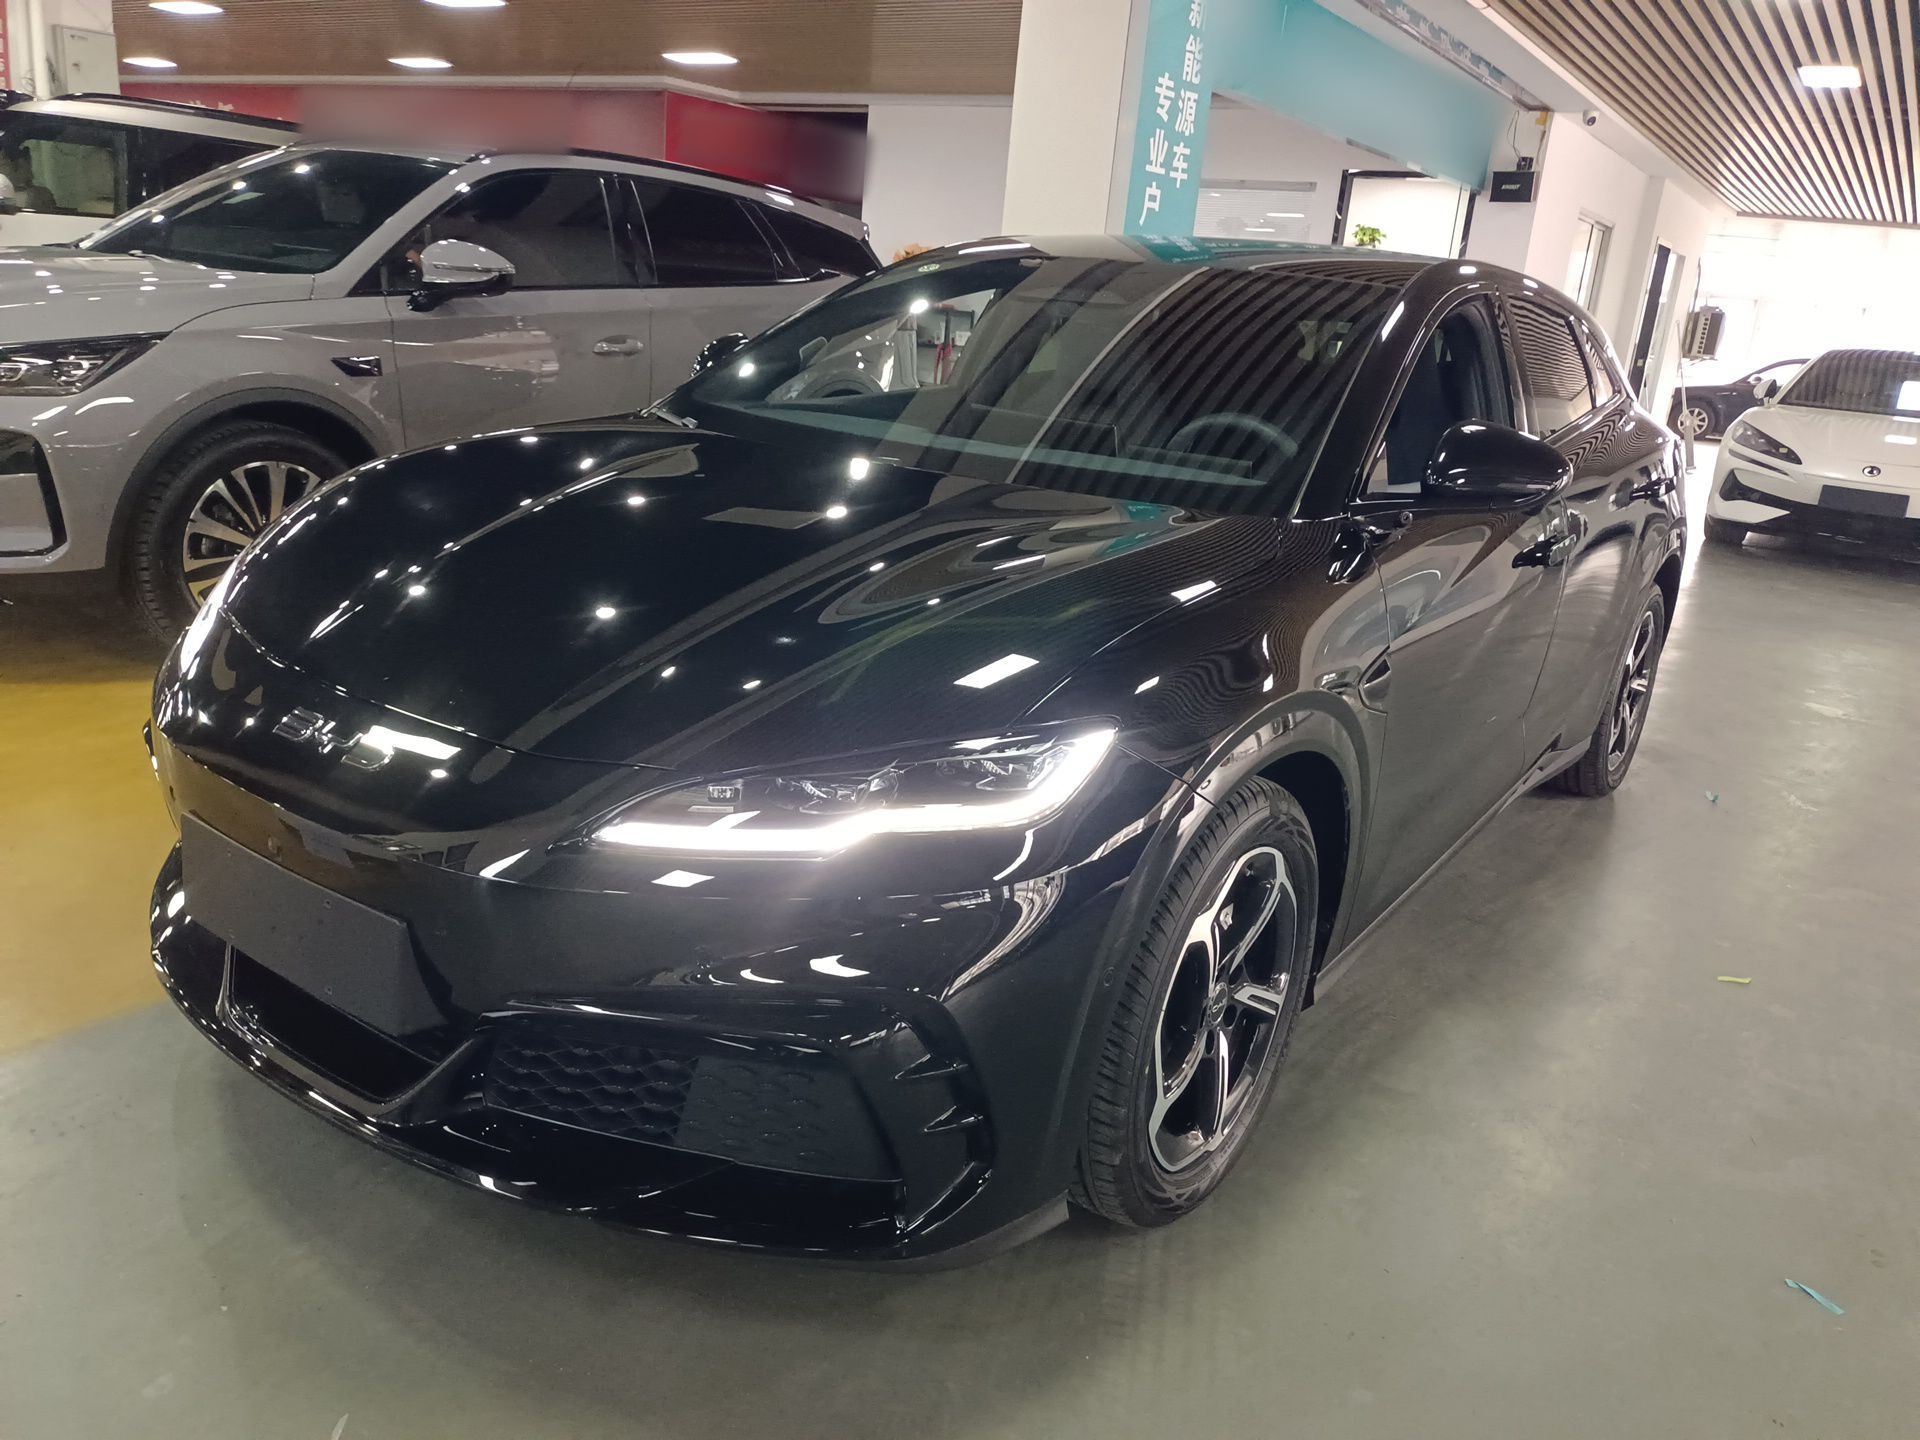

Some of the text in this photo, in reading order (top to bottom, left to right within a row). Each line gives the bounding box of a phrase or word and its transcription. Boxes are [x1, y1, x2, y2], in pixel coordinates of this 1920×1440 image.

[1139, 72, 1175, 226] 专业户
[272, 706, 394, 769] BYD
